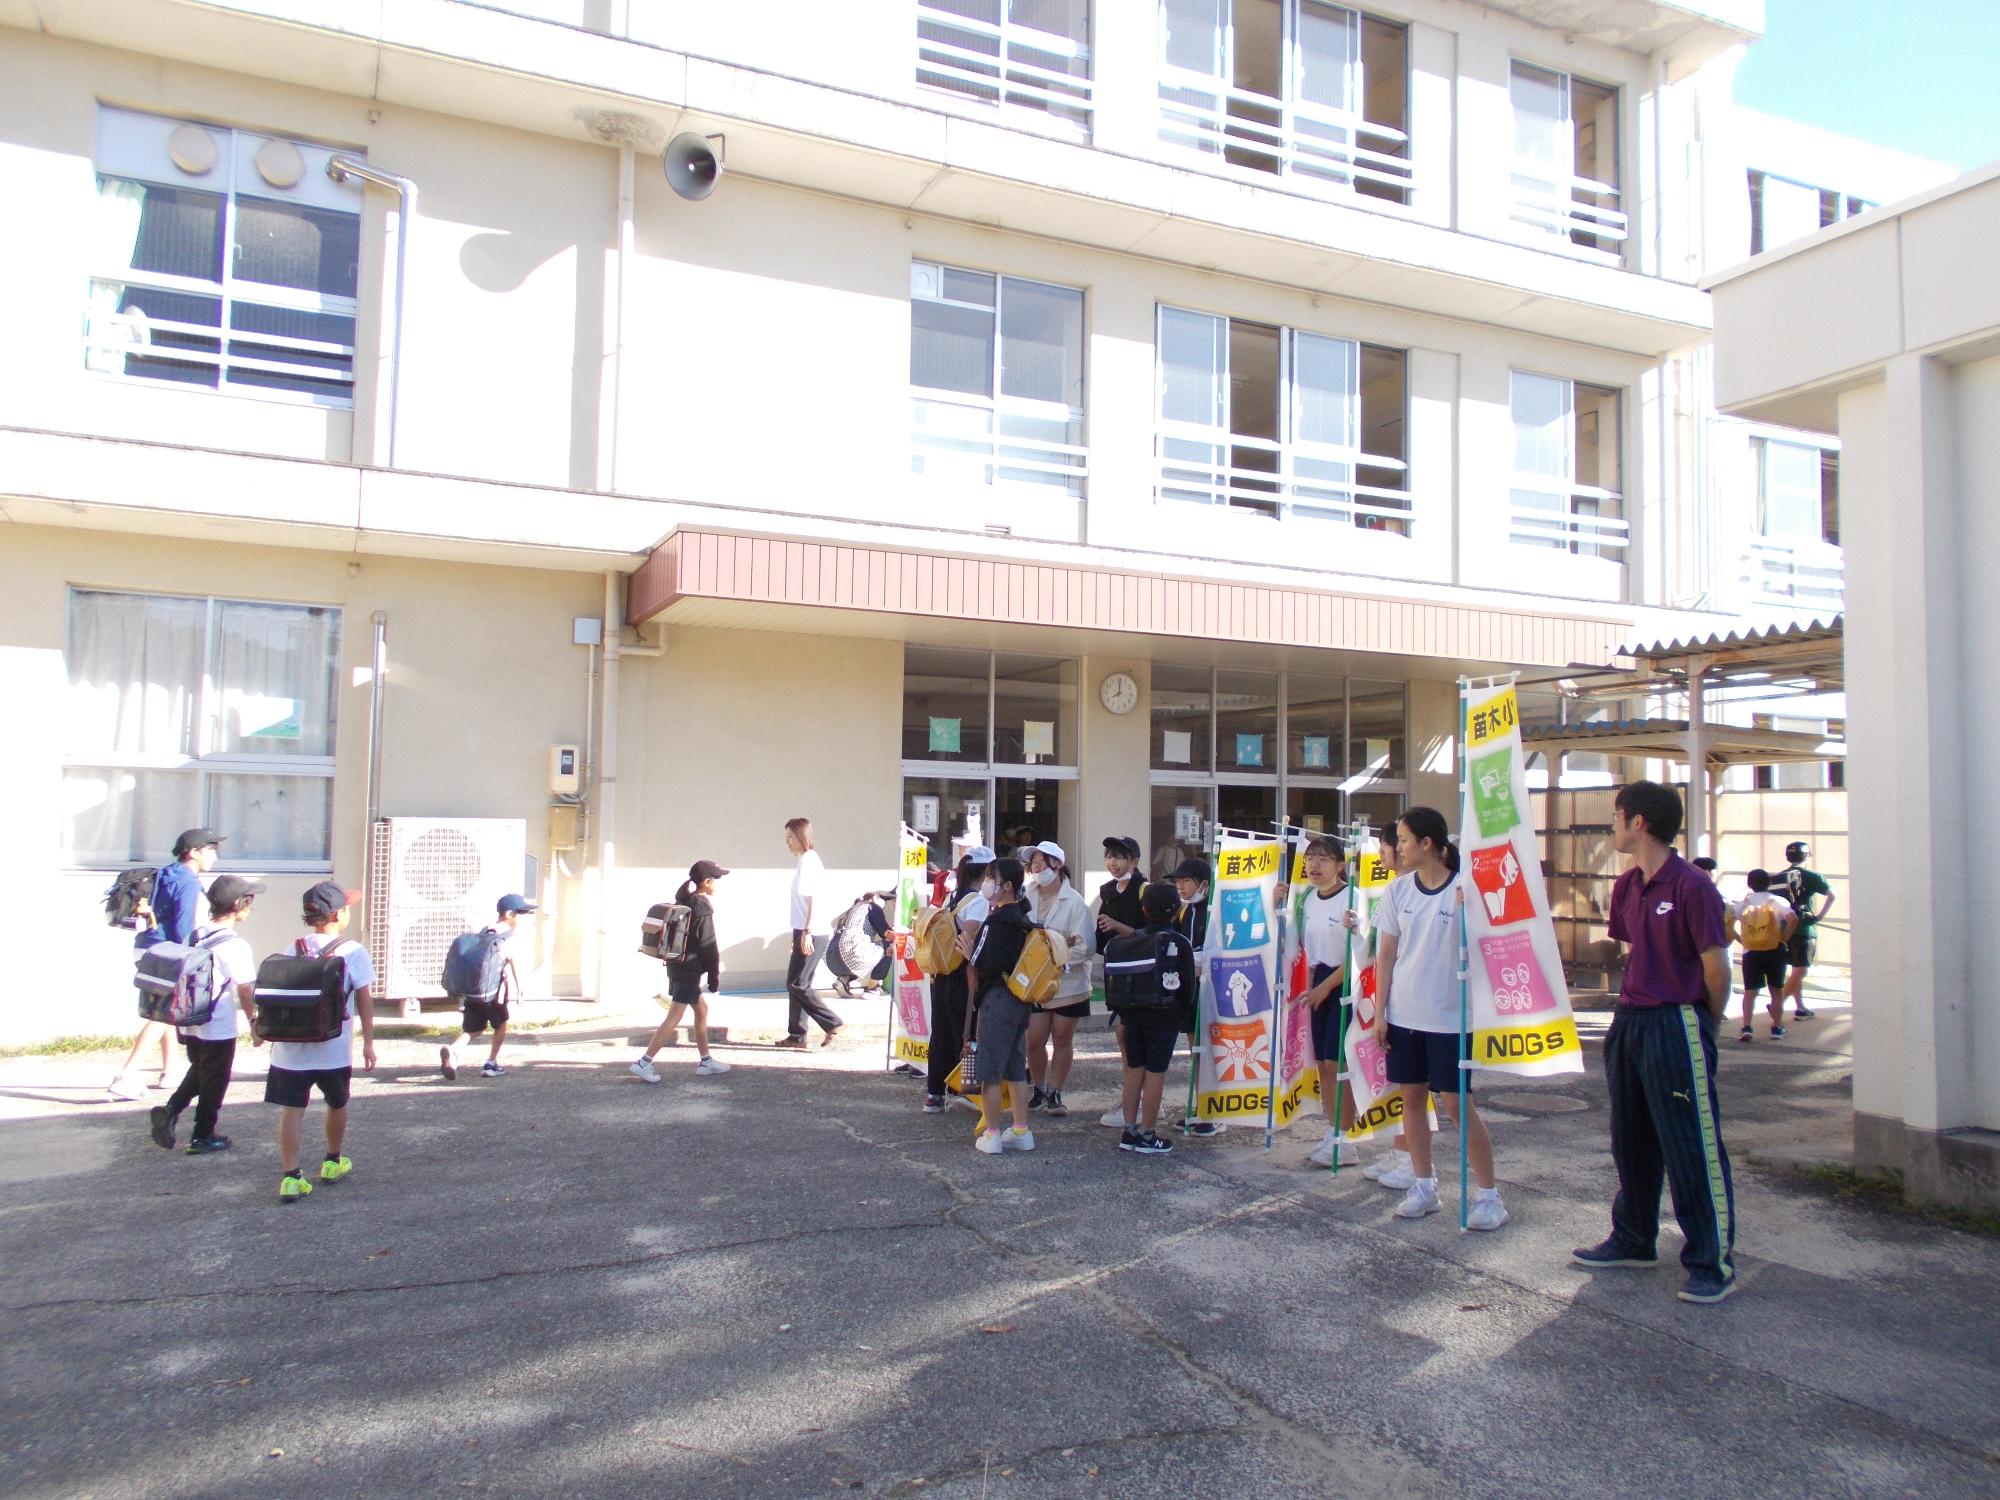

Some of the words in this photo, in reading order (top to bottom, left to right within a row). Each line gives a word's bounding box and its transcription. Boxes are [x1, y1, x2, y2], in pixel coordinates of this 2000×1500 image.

[1473, 698, 1513, 739] 苗木小
[1226, 850, 1270, 875] 苗木小
[1486, 1031, 1565, 1058] NDGs
[1207, 1093, 1271, 1114] NDGs
[1350, 1096, 1404, 1133] NDG
